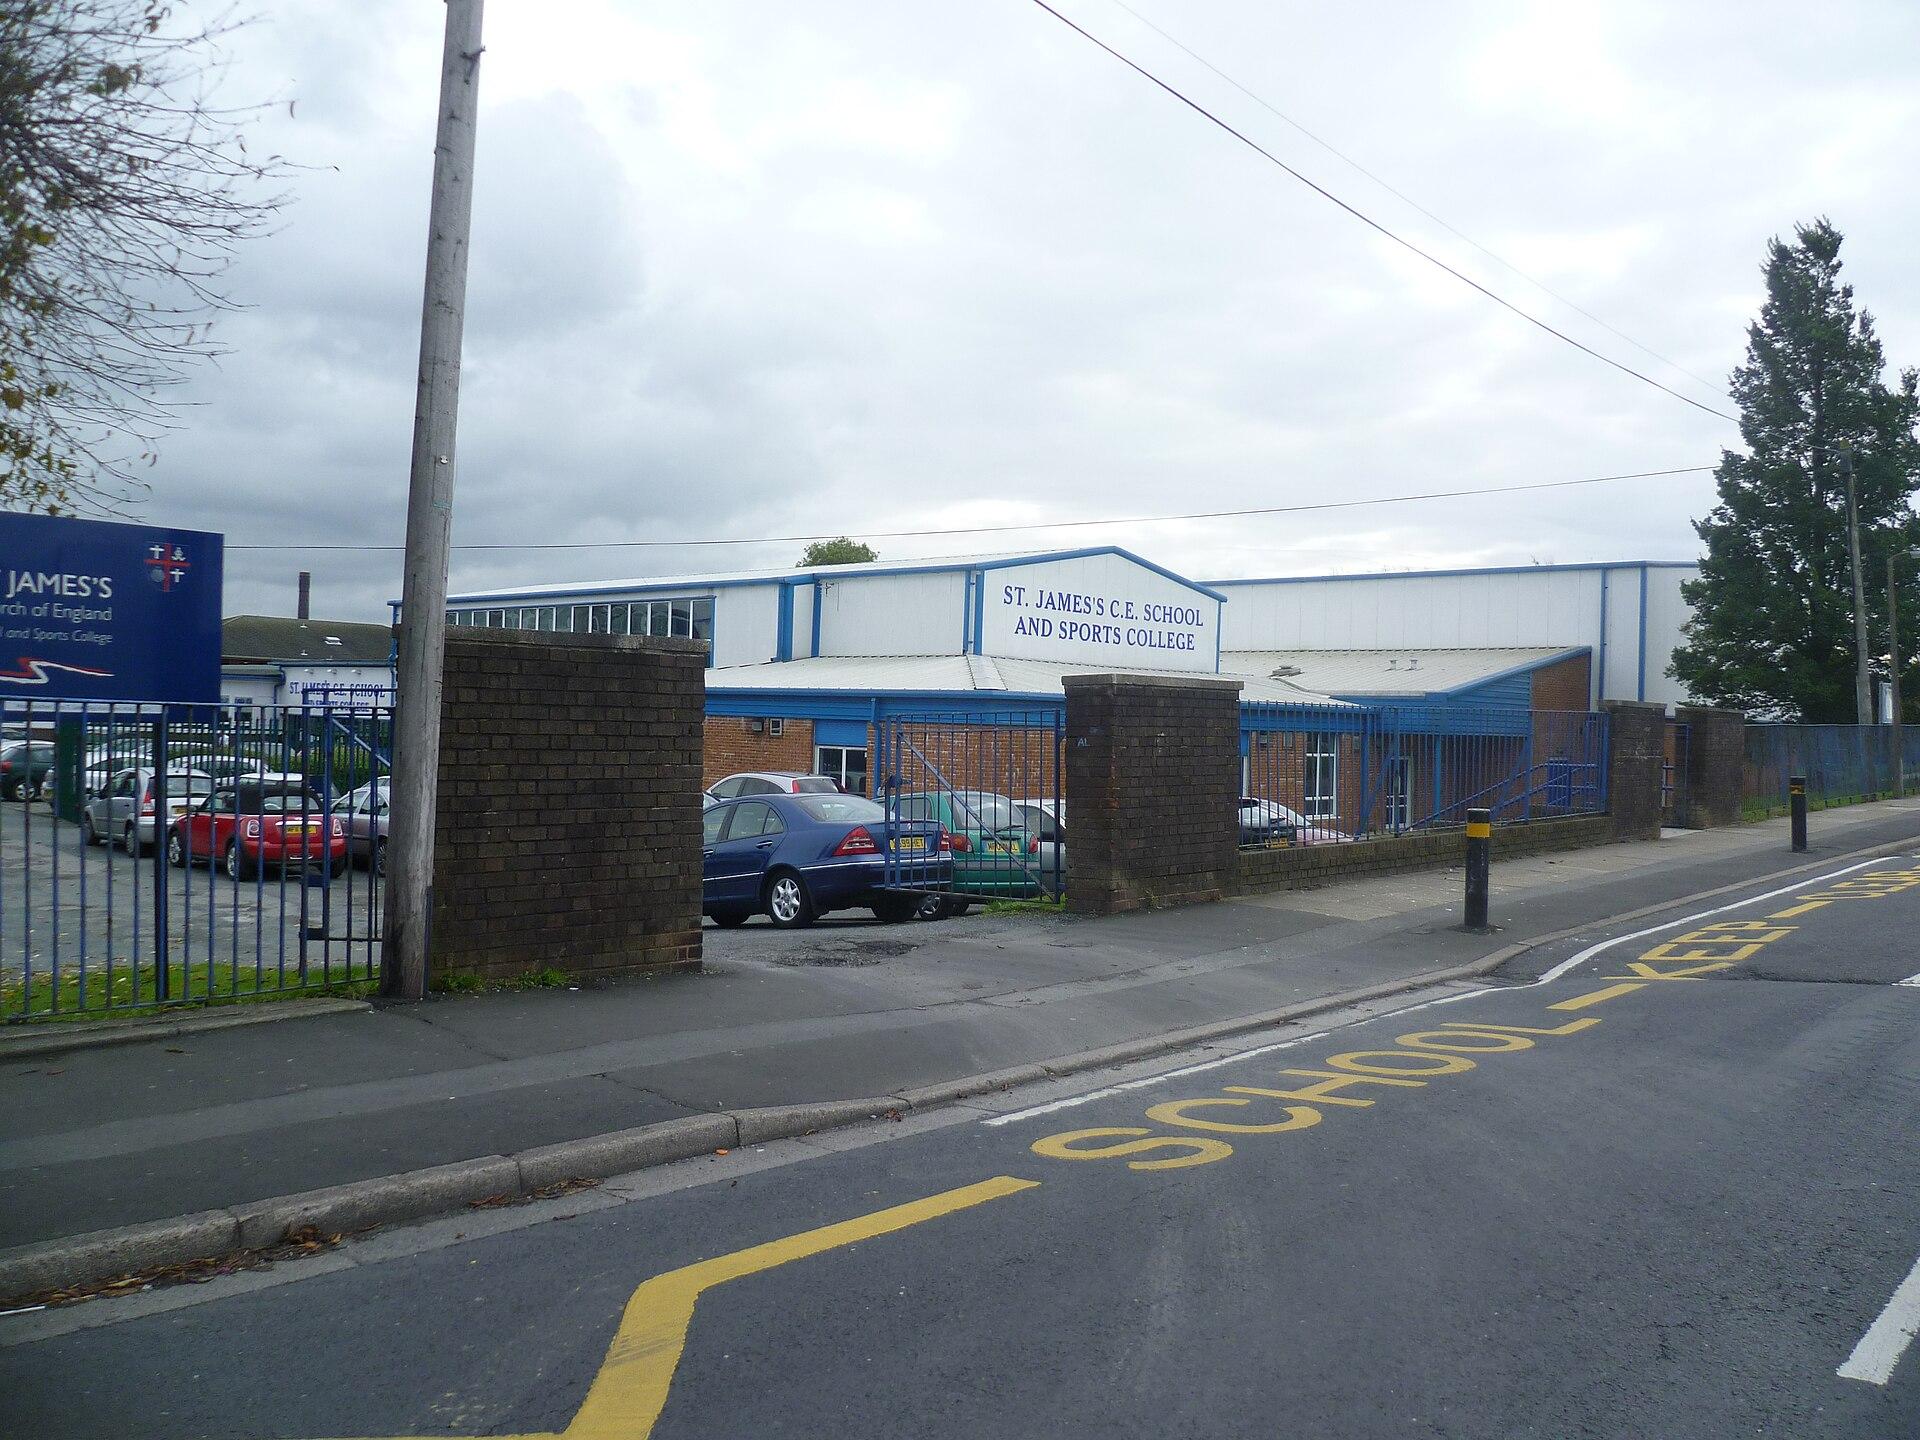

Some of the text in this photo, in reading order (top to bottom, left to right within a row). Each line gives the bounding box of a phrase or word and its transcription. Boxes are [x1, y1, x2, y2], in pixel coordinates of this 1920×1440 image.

[6, 569, 113, 598] JAMES'S
[31, 602, 50, 617] of
[53, 603, 112, 623] England
[1003, 585, 1204, 627] ST. JAMES'S C.E. SCHOOL
[6, 629, 30, 639] and
[33, 627, 69, 641] Sports
[72, 629, 113, 646] College
[1014, 616, 1195, 650] AND SPORTS COLLEGE
[1031, 1018, 1602, 1171] SCHOOL
[1600, 921, 1800, 981] KEEP
